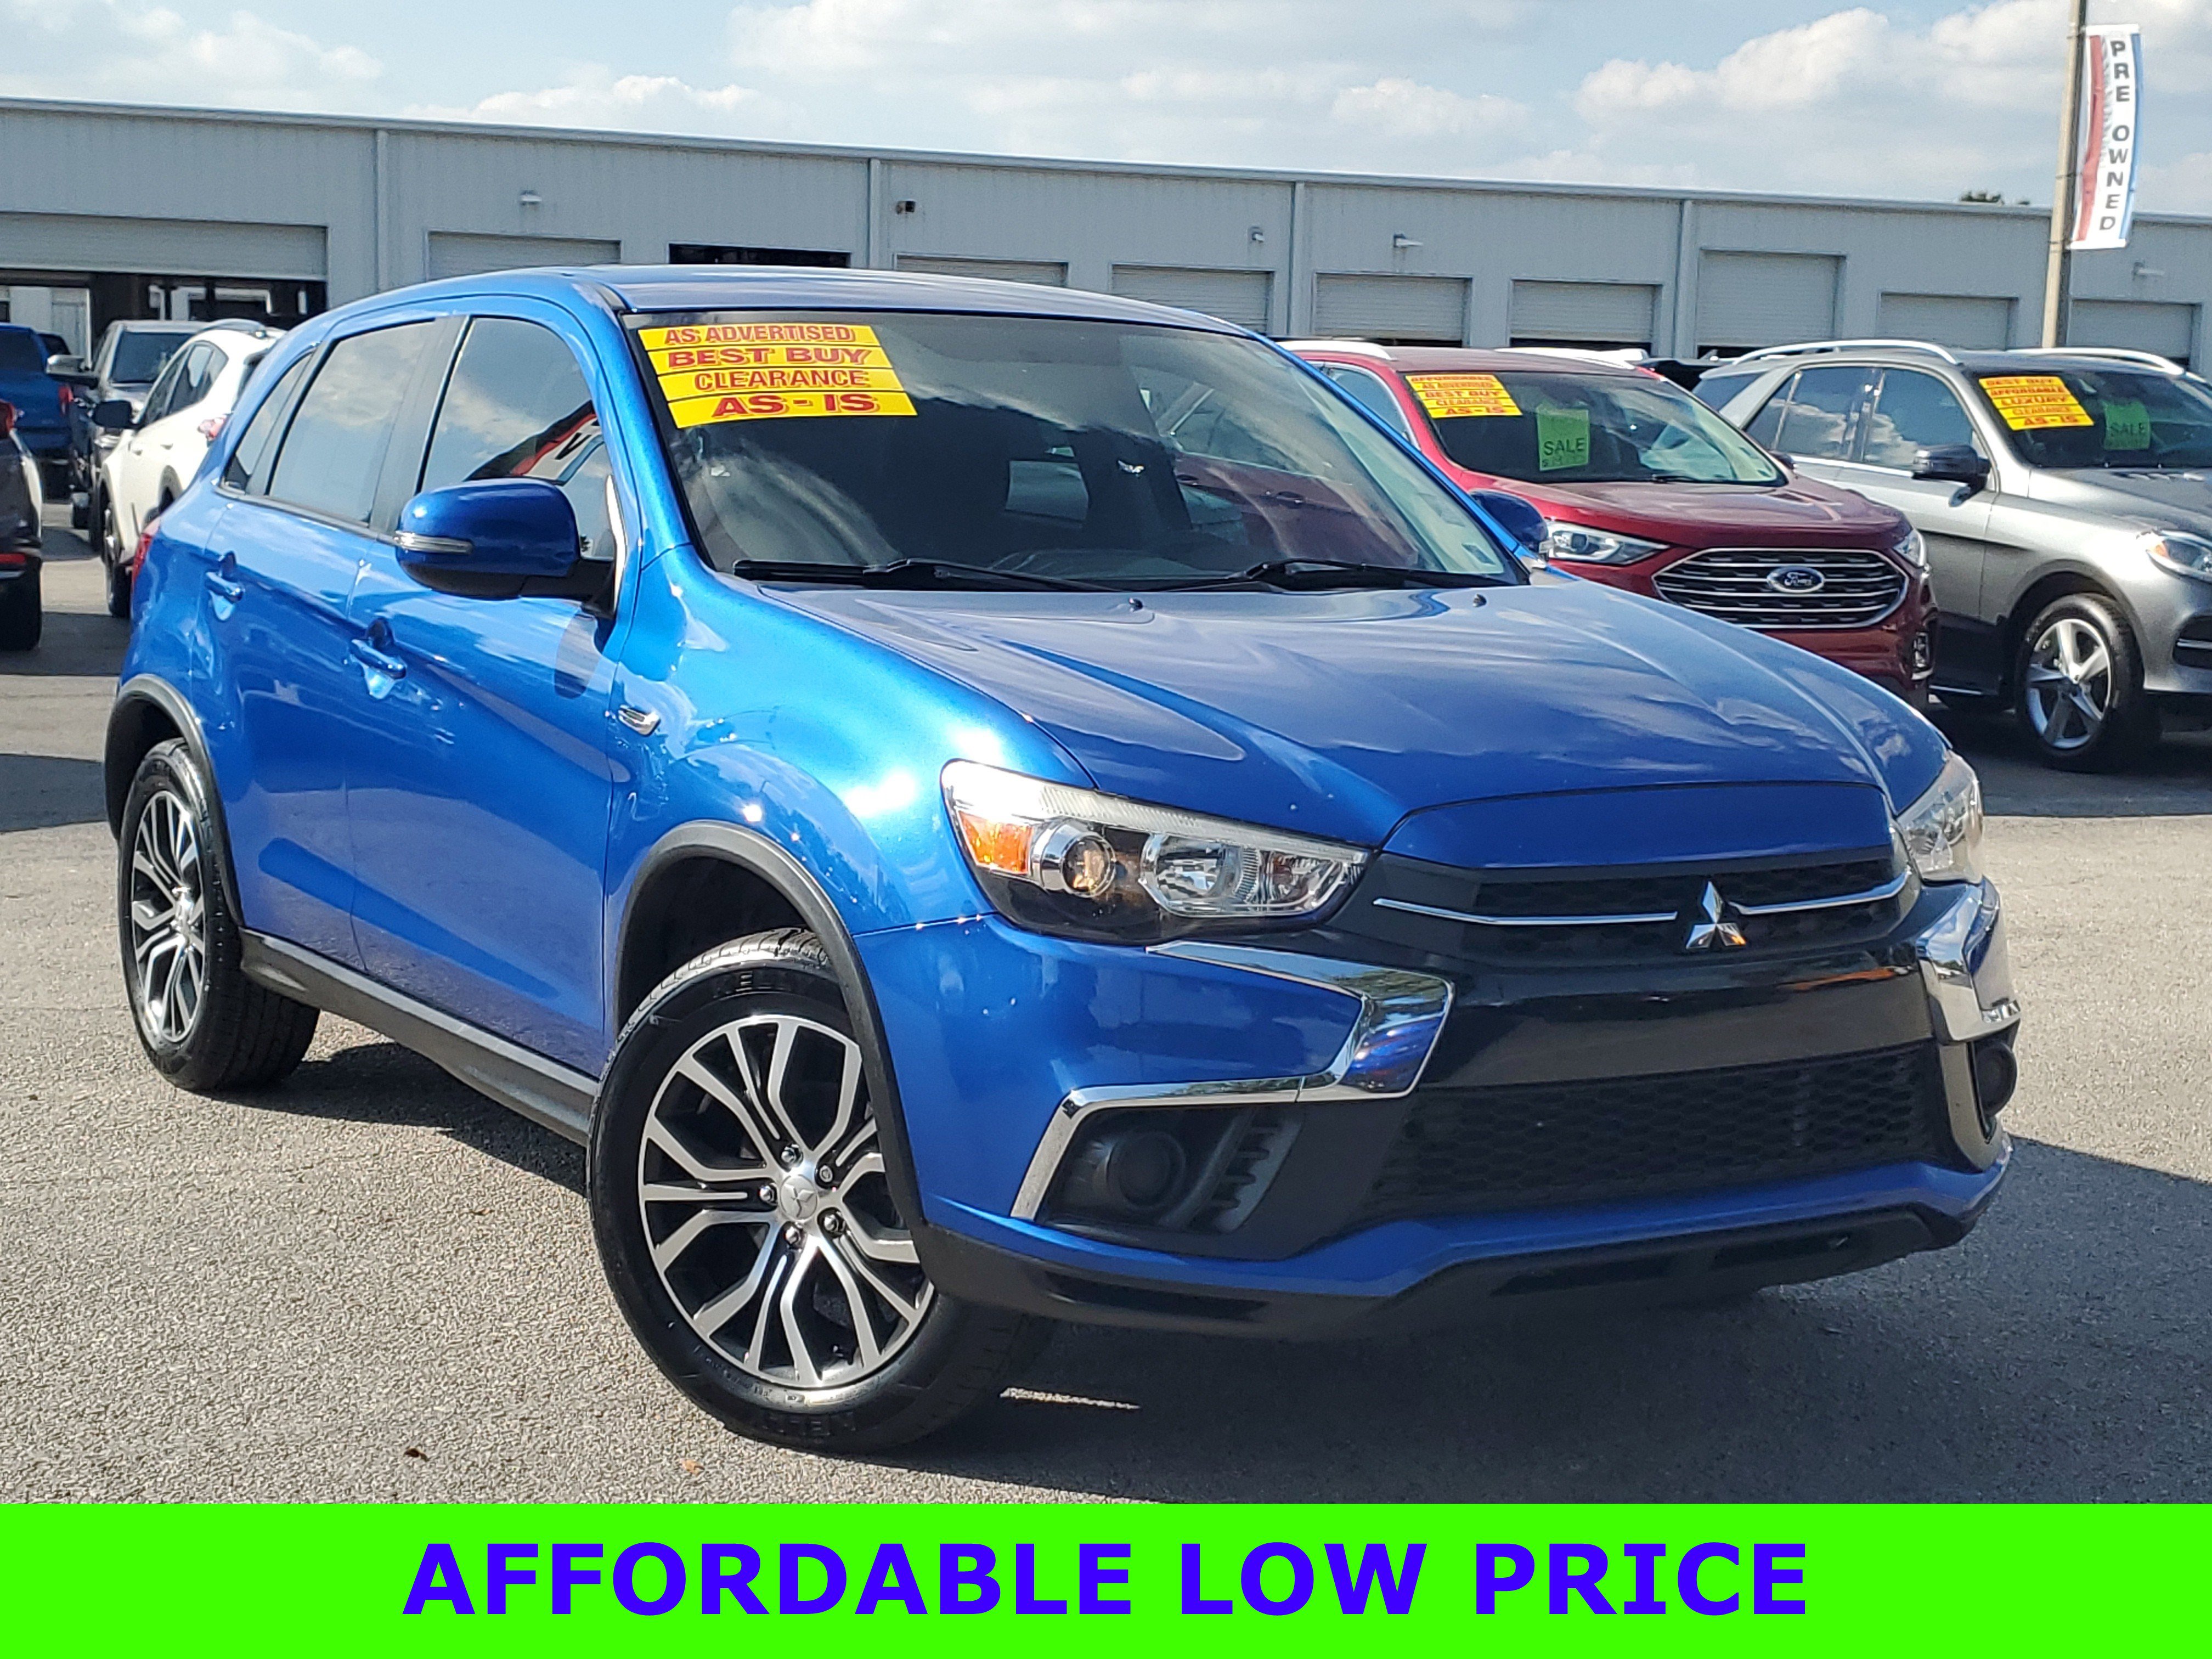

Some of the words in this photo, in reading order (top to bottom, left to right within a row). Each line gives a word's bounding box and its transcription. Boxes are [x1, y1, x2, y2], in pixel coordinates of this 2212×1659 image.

[2110, 40, 2130, 103] PRE
[2099, 124, 2130, 231] OWNED
[664, 328, 701, 345] AS
[706, 325, 856, 343] ADVERTISED
[668, 347, 775, 369] BEST
[785, 347, 873, 365] BUY
[695, 370, 871, 391] CLEARANCE
[2000, 396, 2067, 406] LUXURY
[2110, 422, 2146, 437] SALE
[1543, 437, 1585, 456] SALE
[1784, 572, 1814, 586] Ford
